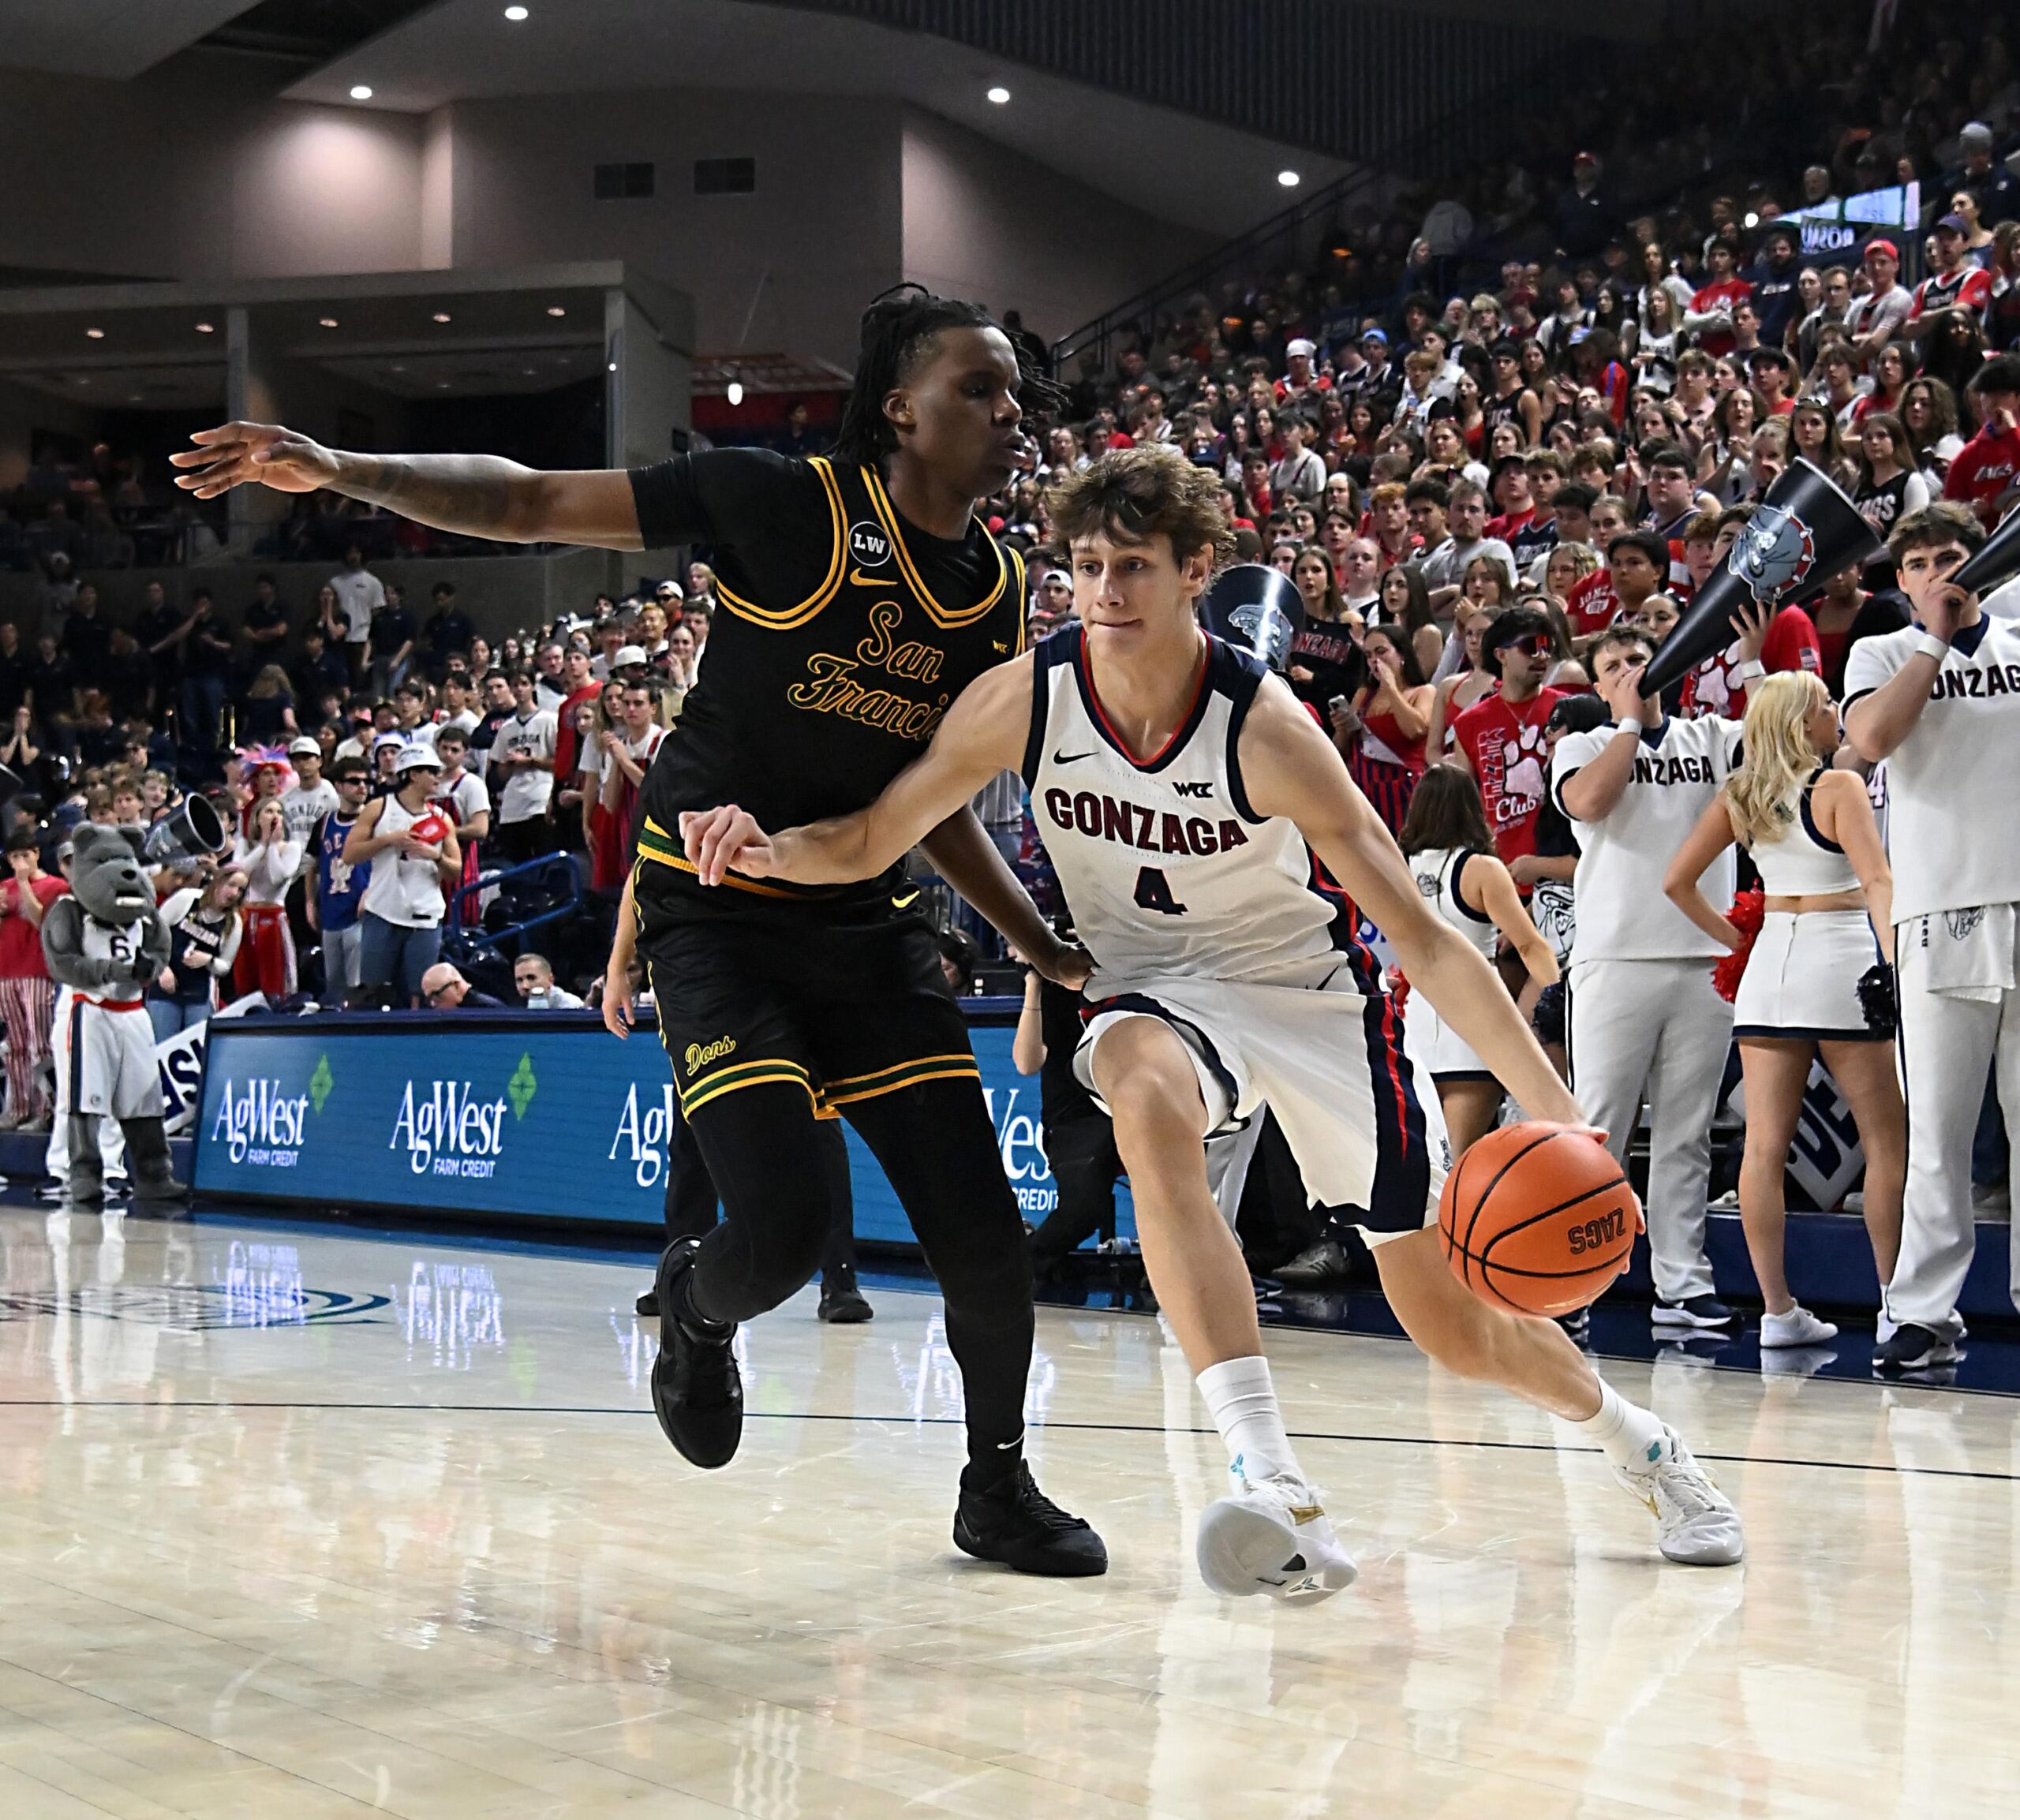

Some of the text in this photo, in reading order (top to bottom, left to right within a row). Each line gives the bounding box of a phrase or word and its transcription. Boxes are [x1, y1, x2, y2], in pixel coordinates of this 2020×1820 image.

[854, 533, 886, 554] LW
[857, 600, 945, 684] San
[1172, 782, 1213, 798] WCC
[1629, 756, 1715, 786] NZAGA
[1045, 788, 1249, 856] GONZAGA
[1496, 793, 1536, 822] Club
[1133, 865, 1188, 916] 4
[685, 1035, 736, 1076] Dons
[211, 1078, 309, 1164] AgWest
[389, 1079, 507, 1174] AgWest
[248, 1148, 298, 1167] FARM CREDIT
[434, 1157, 496, 1178] FARM CREDIT
[1567, 1207, 1625, 1255] ZAGS
